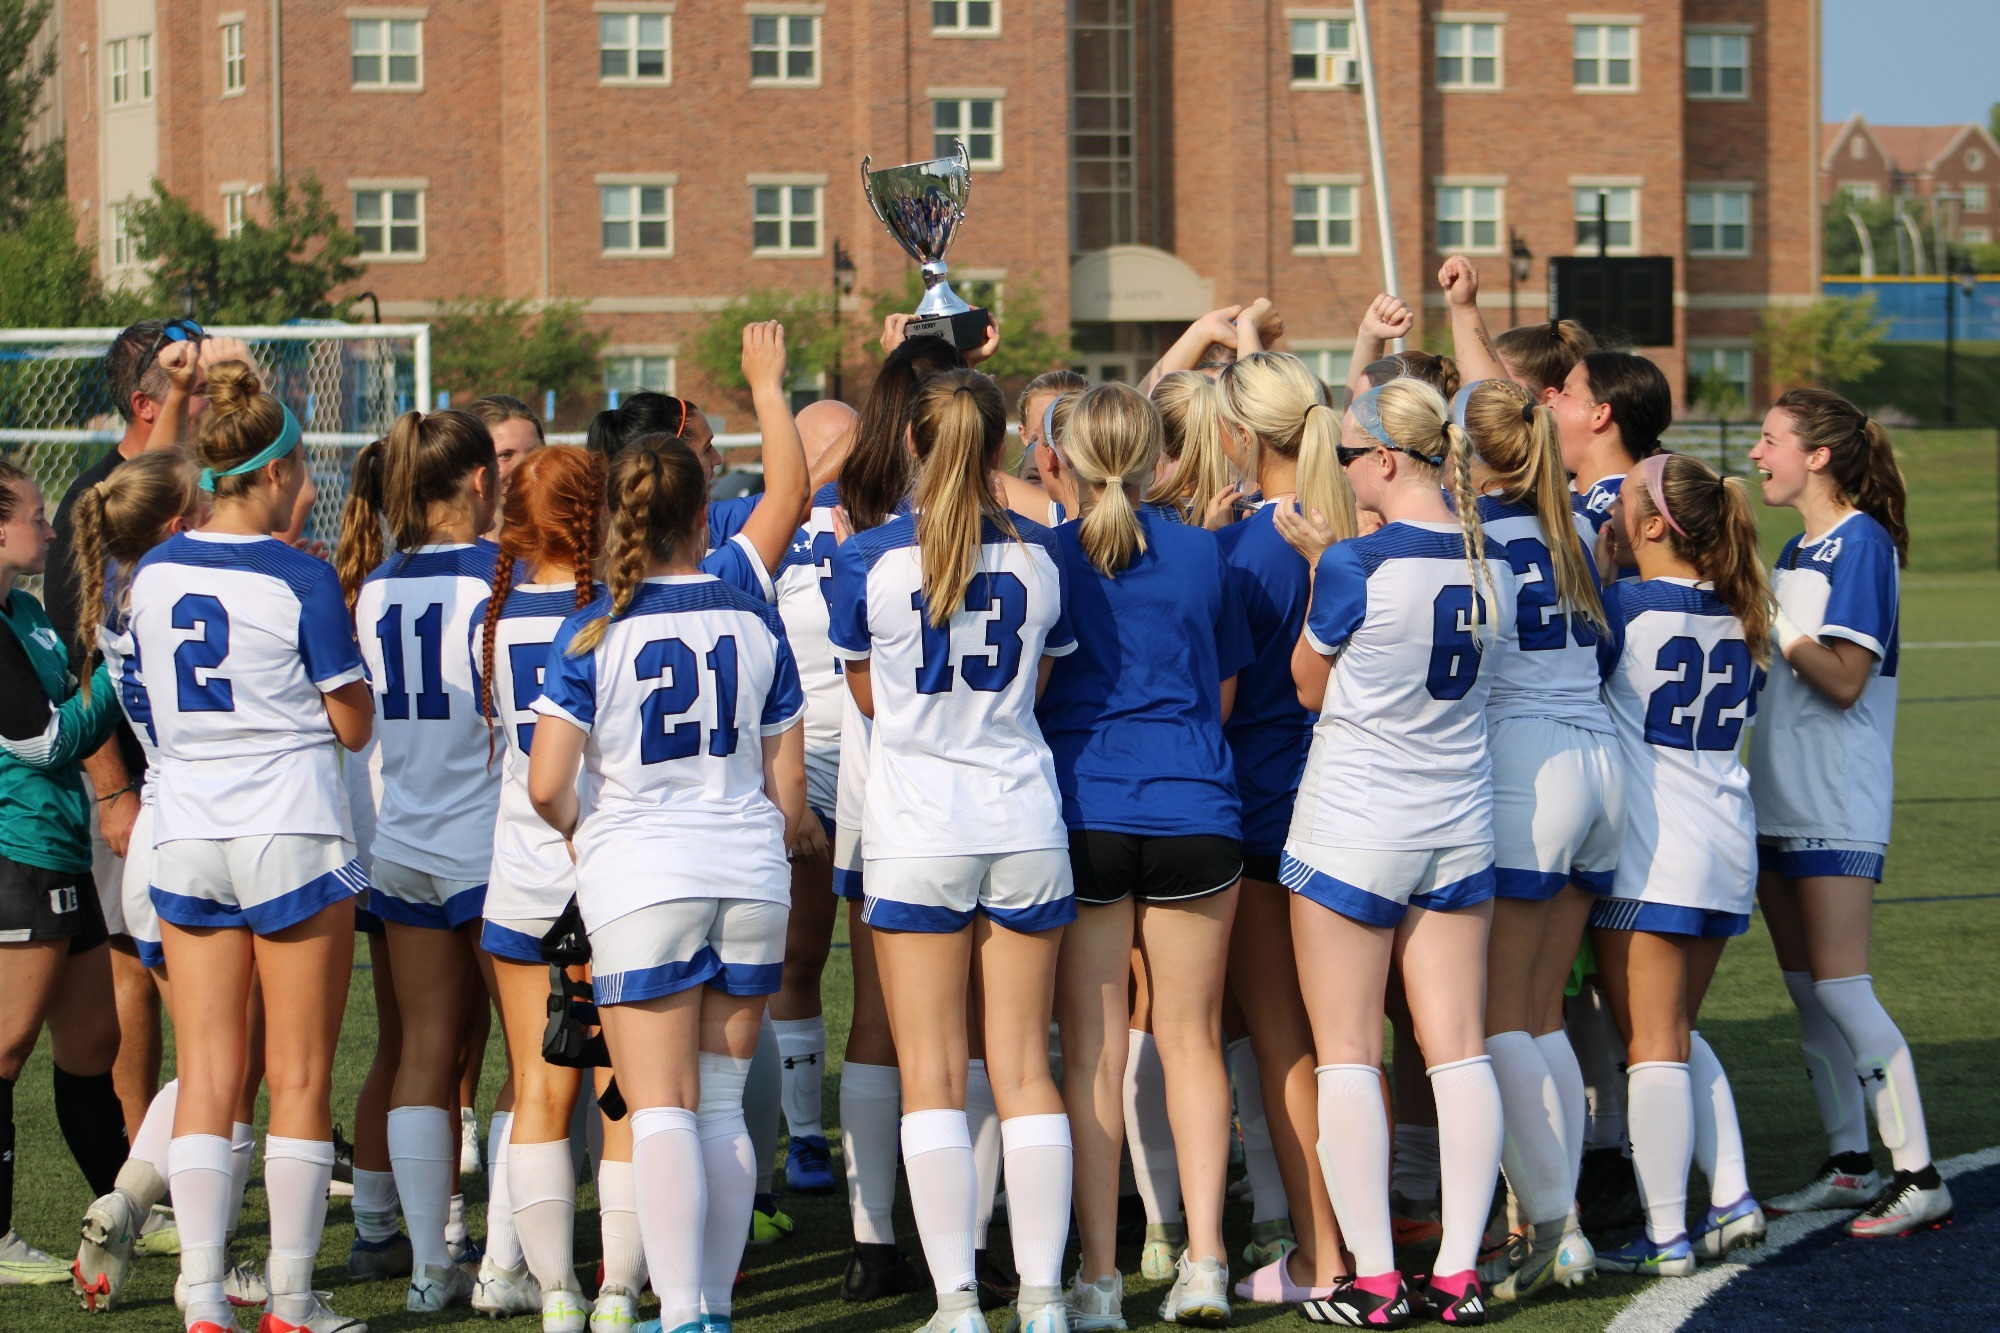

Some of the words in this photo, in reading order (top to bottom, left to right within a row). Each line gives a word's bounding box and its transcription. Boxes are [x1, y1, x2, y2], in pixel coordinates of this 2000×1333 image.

[172, 593, 235, 712] 2
[376, 603, 450, 720] 11
[911, 572, 1027, 695] 13
[1425, 585, 1486, 700] 6
[634, 634, 739, 765] 21
[1644, 636, 1752, 751] 22
